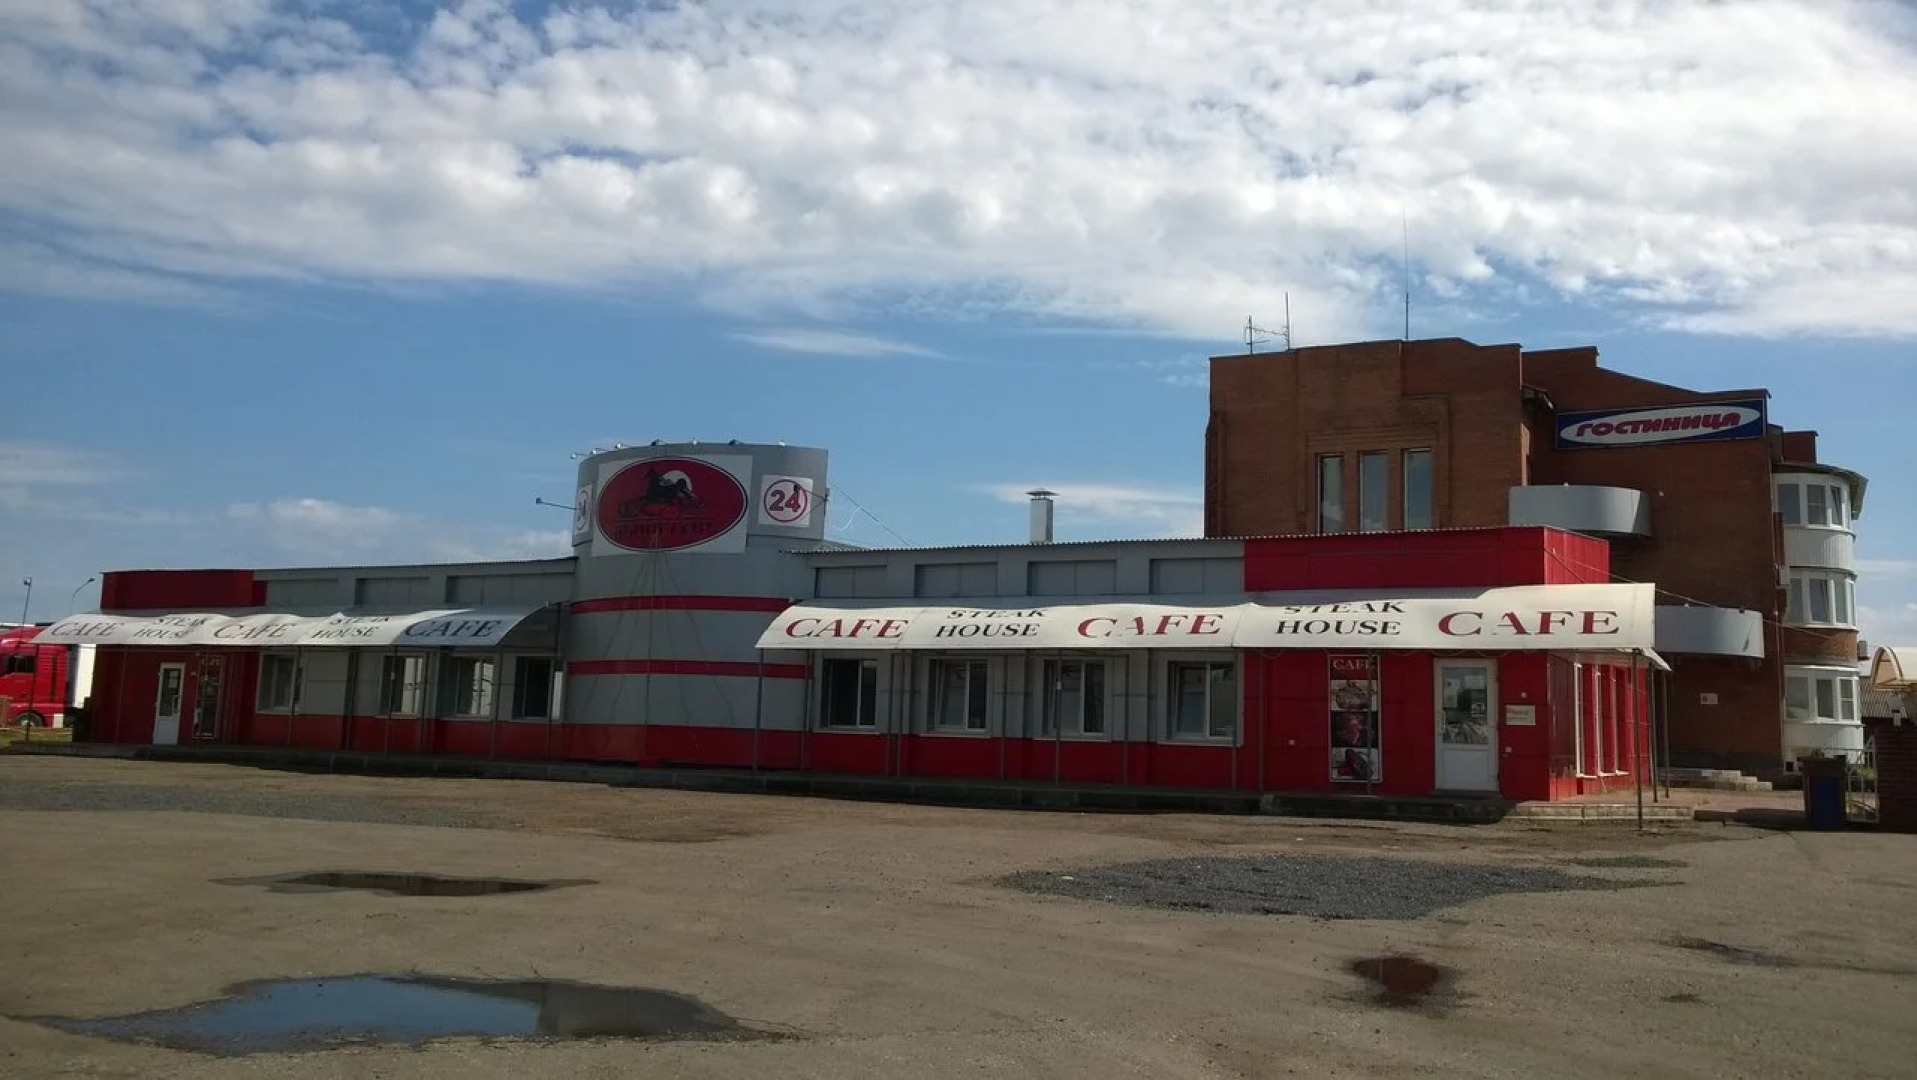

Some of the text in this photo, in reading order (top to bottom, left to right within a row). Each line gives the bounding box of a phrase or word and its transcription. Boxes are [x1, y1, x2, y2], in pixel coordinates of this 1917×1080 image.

[1576, 411, 1741, 438] ГОСТИНИЦА
[770, 489, 801, 512] 24
[51, 622, 123, 637] CAFE
[213, 622, 295, 639] CAFE
[404, 619, 502, 638] CAFE
[785, 618, 910, 638] CAFE
[935, 623, 1041, 638] HOUSE
[1077, 613, 1224, 639] CAFE
[1275, 619, 1402, 636] HOUSE
[1438, 610, 1620, 636] CAFE
